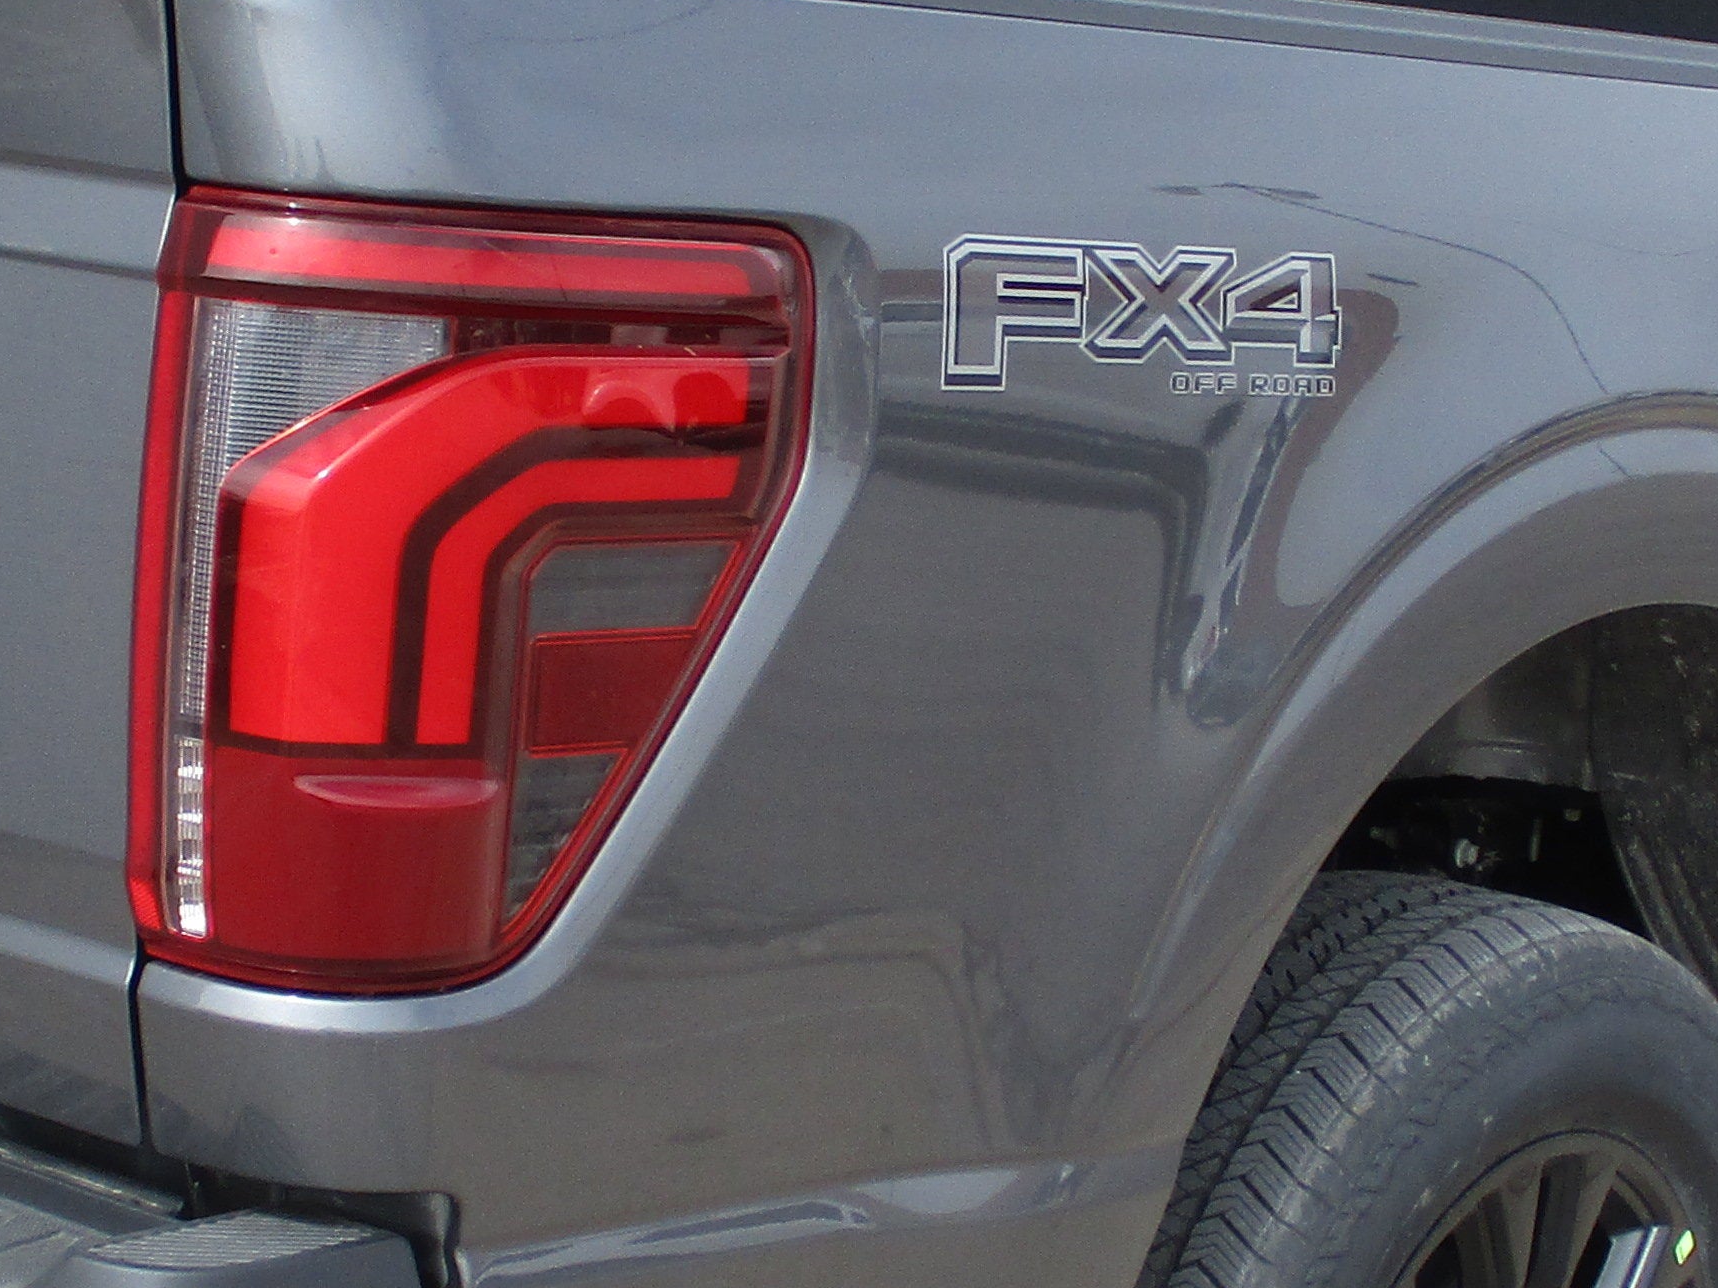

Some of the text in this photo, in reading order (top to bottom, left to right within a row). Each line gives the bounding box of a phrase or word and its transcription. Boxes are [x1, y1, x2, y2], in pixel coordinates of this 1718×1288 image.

[941, 233, 1342, 392] FX4
[1170, 371, 1336, 397] OFF ROAD
